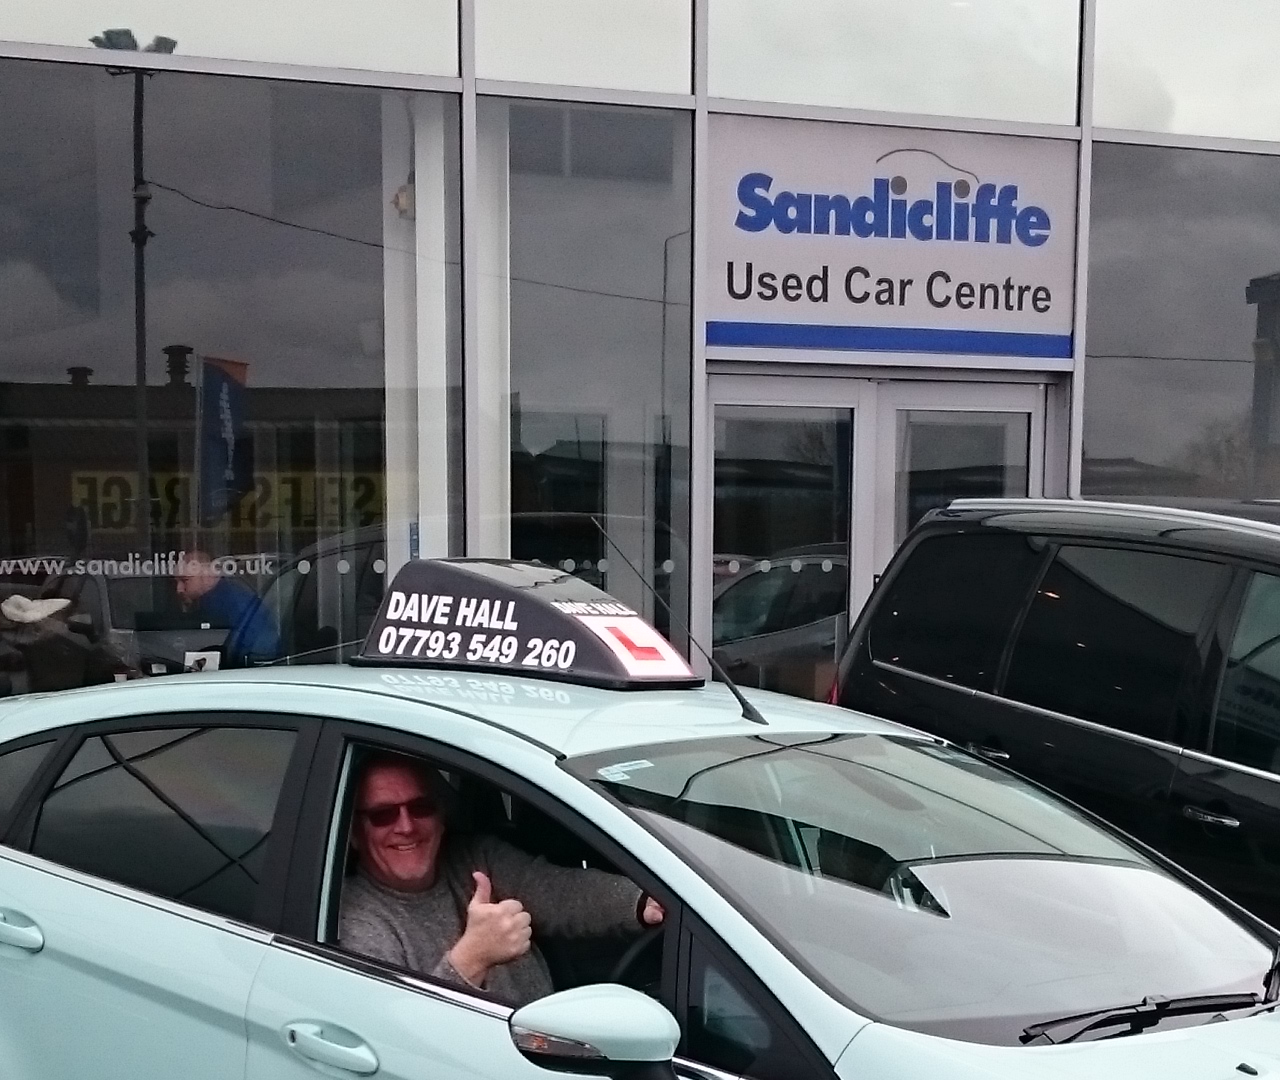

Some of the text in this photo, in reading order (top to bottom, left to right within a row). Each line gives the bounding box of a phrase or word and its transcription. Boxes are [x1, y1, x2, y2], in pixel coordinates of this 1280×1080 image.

[734, 172, 1052, 247] Sandicliffe
[726, 260, 1052, 313] Used Car Centre
[386, 591, 519, 631] DAVE HALL
[378, 626, 576, 669] 07793 549 260
[603, 626, 666, 661] L
